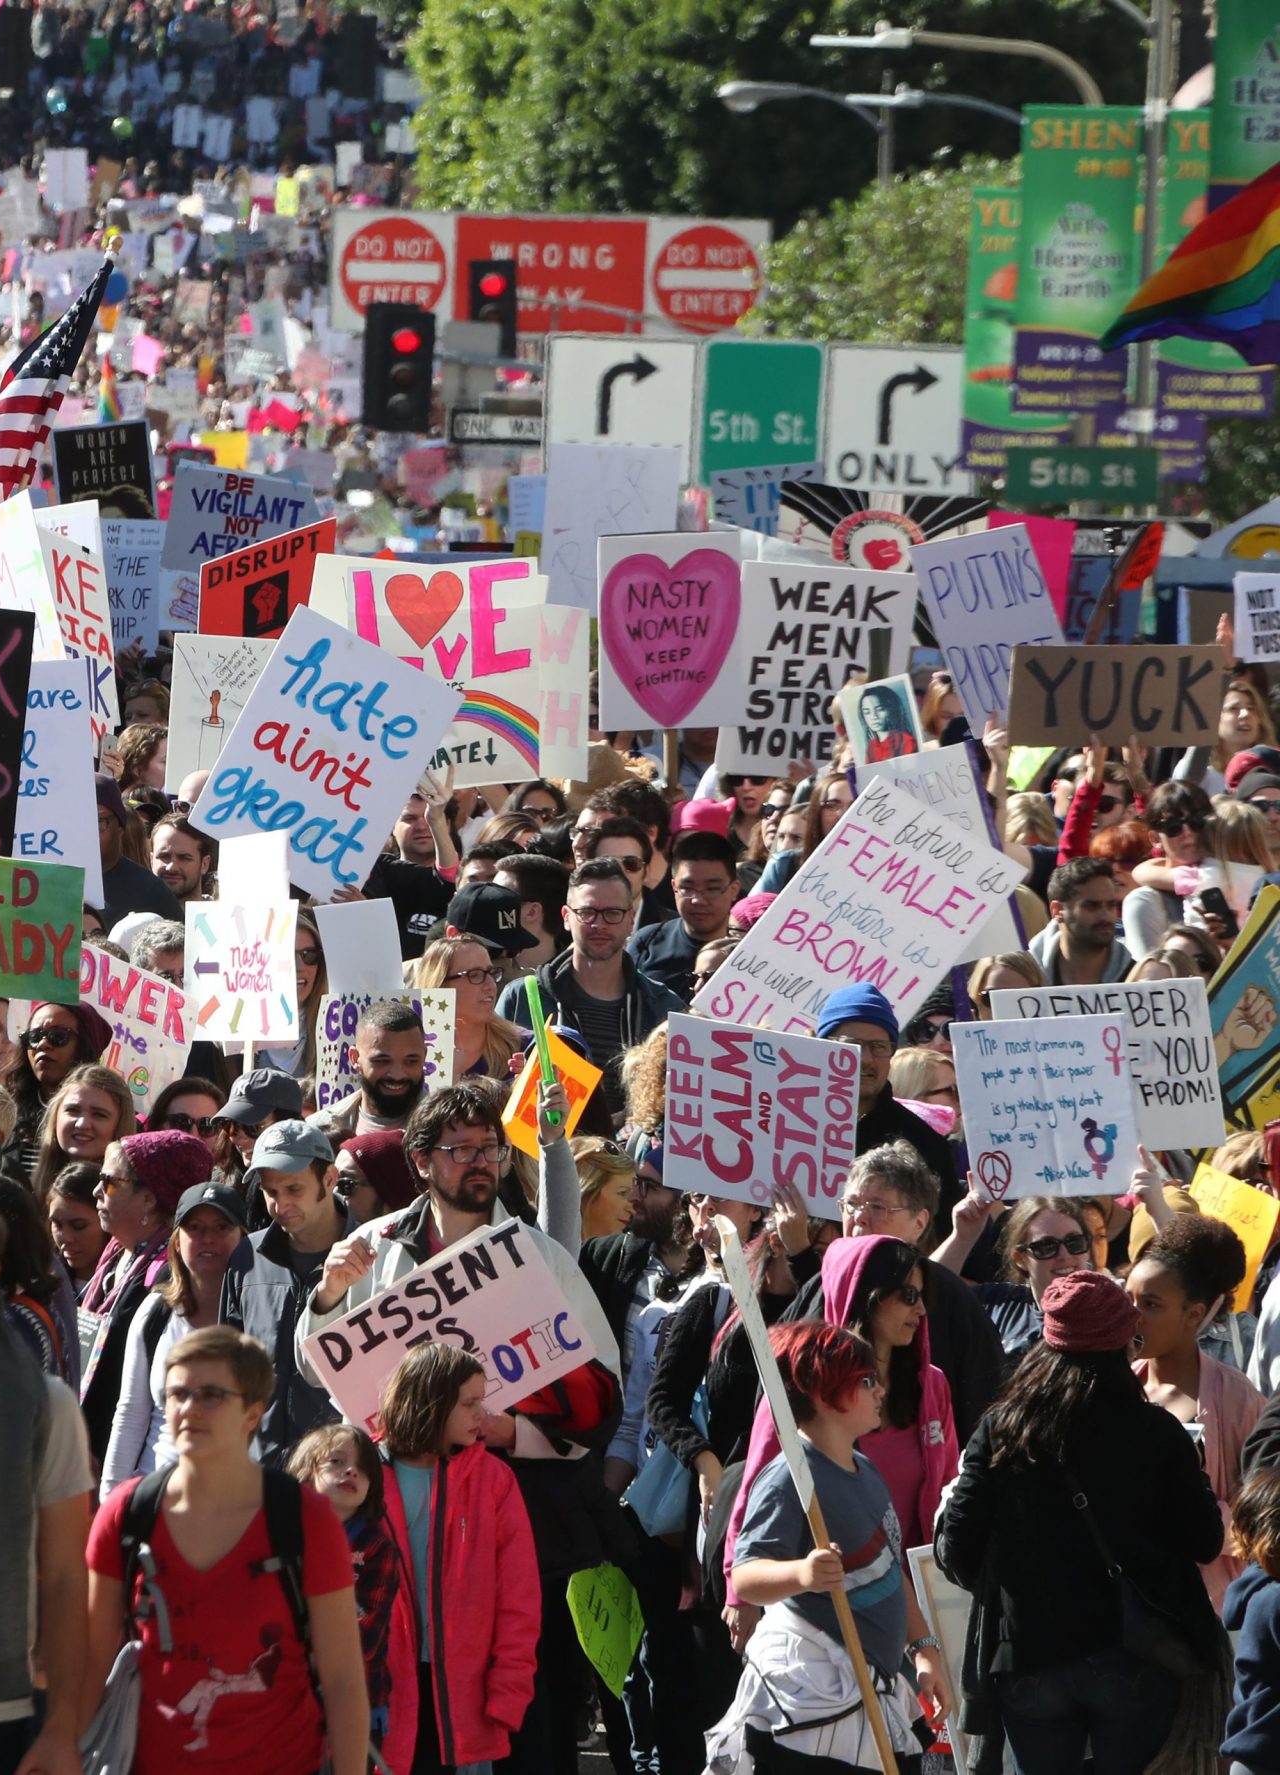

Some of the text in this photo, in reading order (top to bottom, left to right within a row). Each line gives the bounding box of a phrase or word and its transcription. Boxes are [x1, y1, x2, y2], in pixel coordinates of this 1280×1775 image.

[1030, 118, 1138, 150] SHEN
[1055, 217, 1110, 235] Arts
[355, 239, 434, 258] DO NOT
[489, 242, 617, 271] WRONG
[666, 244, 747, 266] DO NOT
[1033, 249, 1126, 269] Heaven
[358, 285, 432, 304] ENTER
[671, 292, 746, 315] ENTER
[1040, 279, 1112, 299] Earth
[75, 429, 128, 448] WOMEN
[454, 412, 493, 438] ONE
[709, 410, 760, 443] 5th
[89, 451, 117, 466] ARE
[837, 450, 962, 487] ONLY
[1028, 456, 1090, 487] 5th
[1102, 462, 1138, 488] St
[71, 464, 137, 487] PERFECT
[190, 487, 306, 529] VIGILANT
[222, 517, 264, 538] NOT
[207, 530, 321, 590] DISRUPT
[927, 536, 1045, 620] PUTIN'S
[131, 586, 152, 611] OF
[627, 579, 713, 614] NASTY
[769, 576, 901, 625] WEAK
[1245, 588, 1276, 611] NOT
[625, 615, 710, 643] WOMEN
[765, 621, 861, 661] MEN
[645, 646, 692, 666] KEEP
[634, 668, 708, 693] FIGHTING
[1023, 654, 1215, 733] YUCK
[280, 637, 418, 761] hate
[252, 720, 373, 813] ain't
[203, 764, 370, 886] great
[856, 786, 1010, 896] the future is
[823, 822, 988, 936] FEMALE!
[798, 865, 940, 969] the future is
[230, 934, 272, 980] nasty
[772, 908, 922, 1009] BROWN!
[223, 968, 275, 998] women
[767, 968, 810, 1005] will
[113, 1021, 148, 1055] the
[1004, 1037, 1032, 1057] most
[1034, 1040, 1068, 1054] common
[1152, 1036, 1211, 1078] YOU
[980, 1062, 1097, 1088] people up their power
[669, 1034, 705, 1161] KEEP
[702, 1030, 754, 1184] CALM
[1138, 1077, 1216, 1107] FROM!
[757, 1091, 773, 1135] AND
[772, 1047, 822, 1199] STAY
[820, 1047, 858, 1199] STRONG
[990, 1102, 1002, 1117] is
[1004, 1103, 1018, 1131] by
[1018, 1095, 1058, 1129] thinking
[1057, 1096, 1078, 1122] they
[989, 1130, 1013, 1146] have
[1065, 1160, 1093, 1181] Walker
[1194, 1172, 1229, 1214] Girls
[319, 1221, 526, 1373] DISSENT
